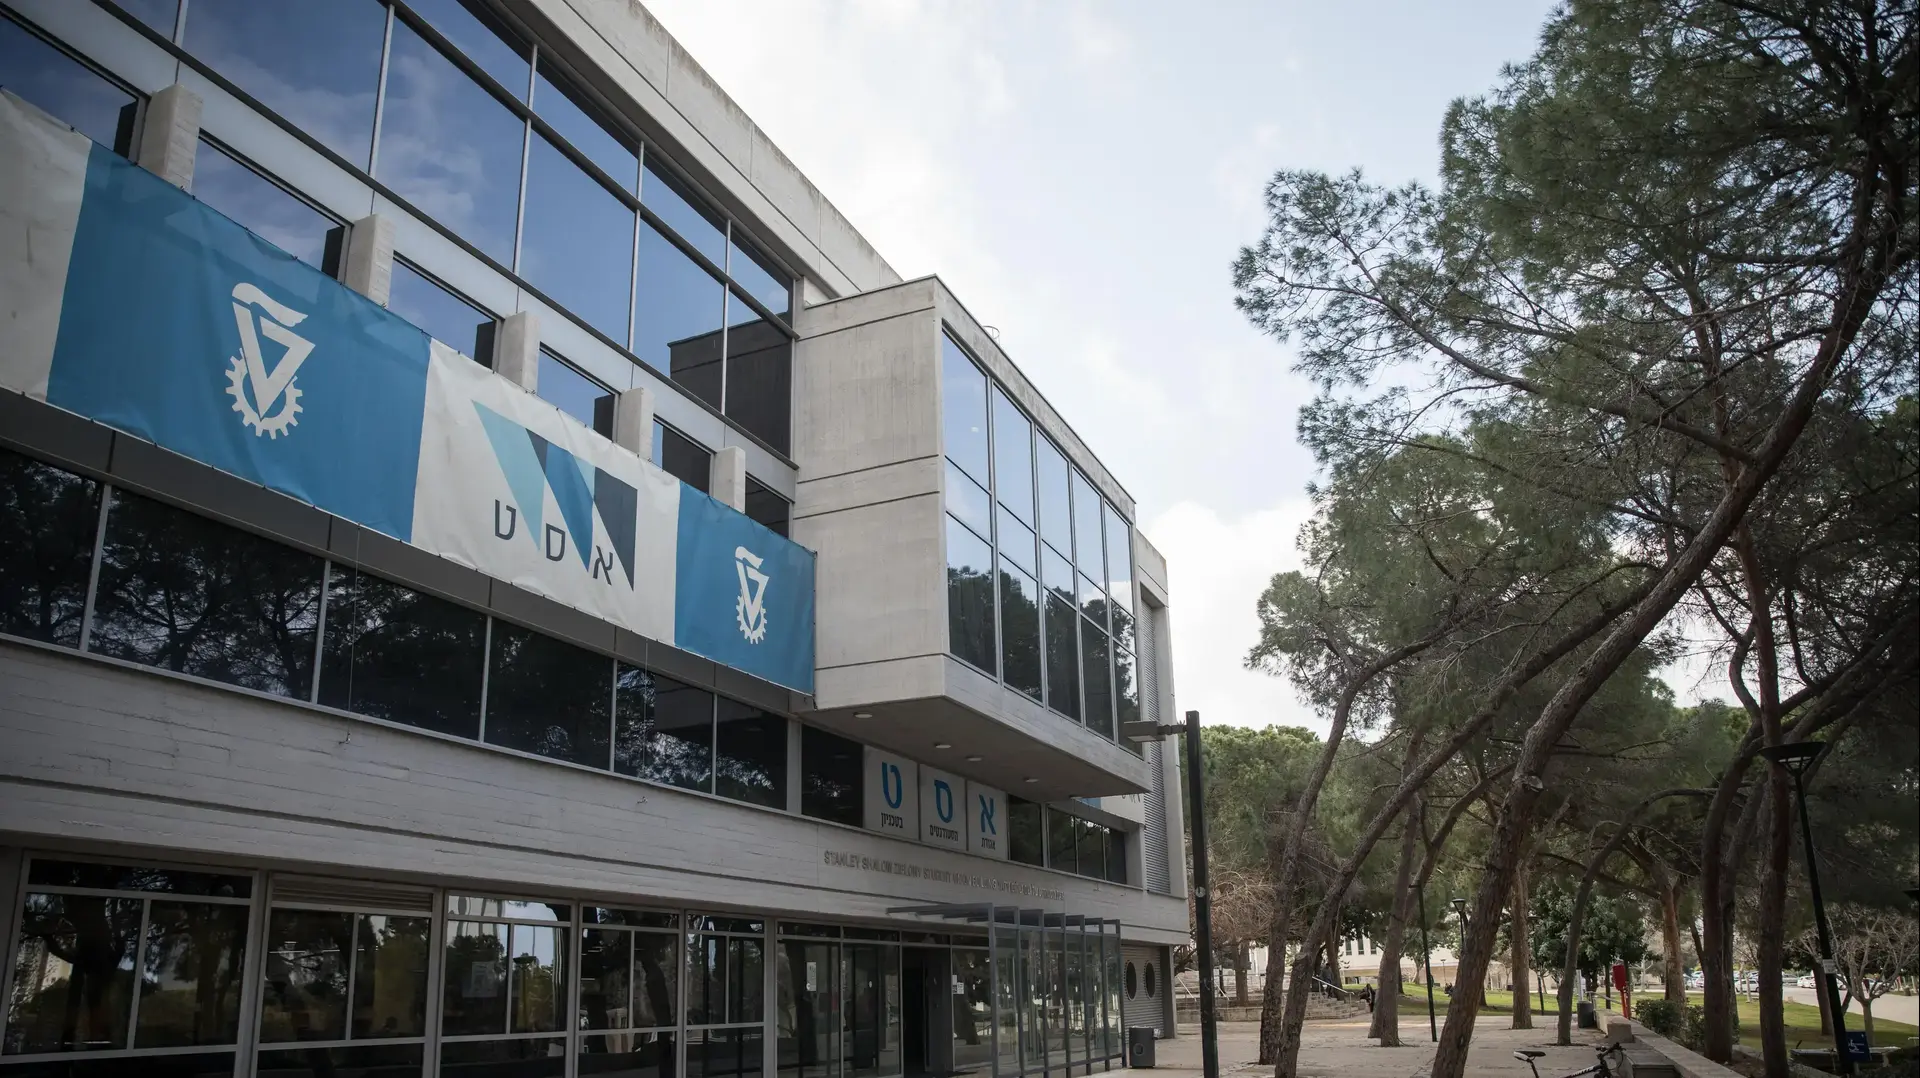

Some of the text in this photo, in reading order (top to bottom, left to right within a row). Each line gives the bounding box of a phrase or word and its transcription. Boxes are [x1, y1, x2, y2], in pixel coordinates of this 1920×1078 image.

[880, 812, 904, 829] בטכניון
[929, 824, 959, 842] הסטודנטים
[823, 849, 860, 869] STANLEY
[861, 857, 893, 874] SHALOM
